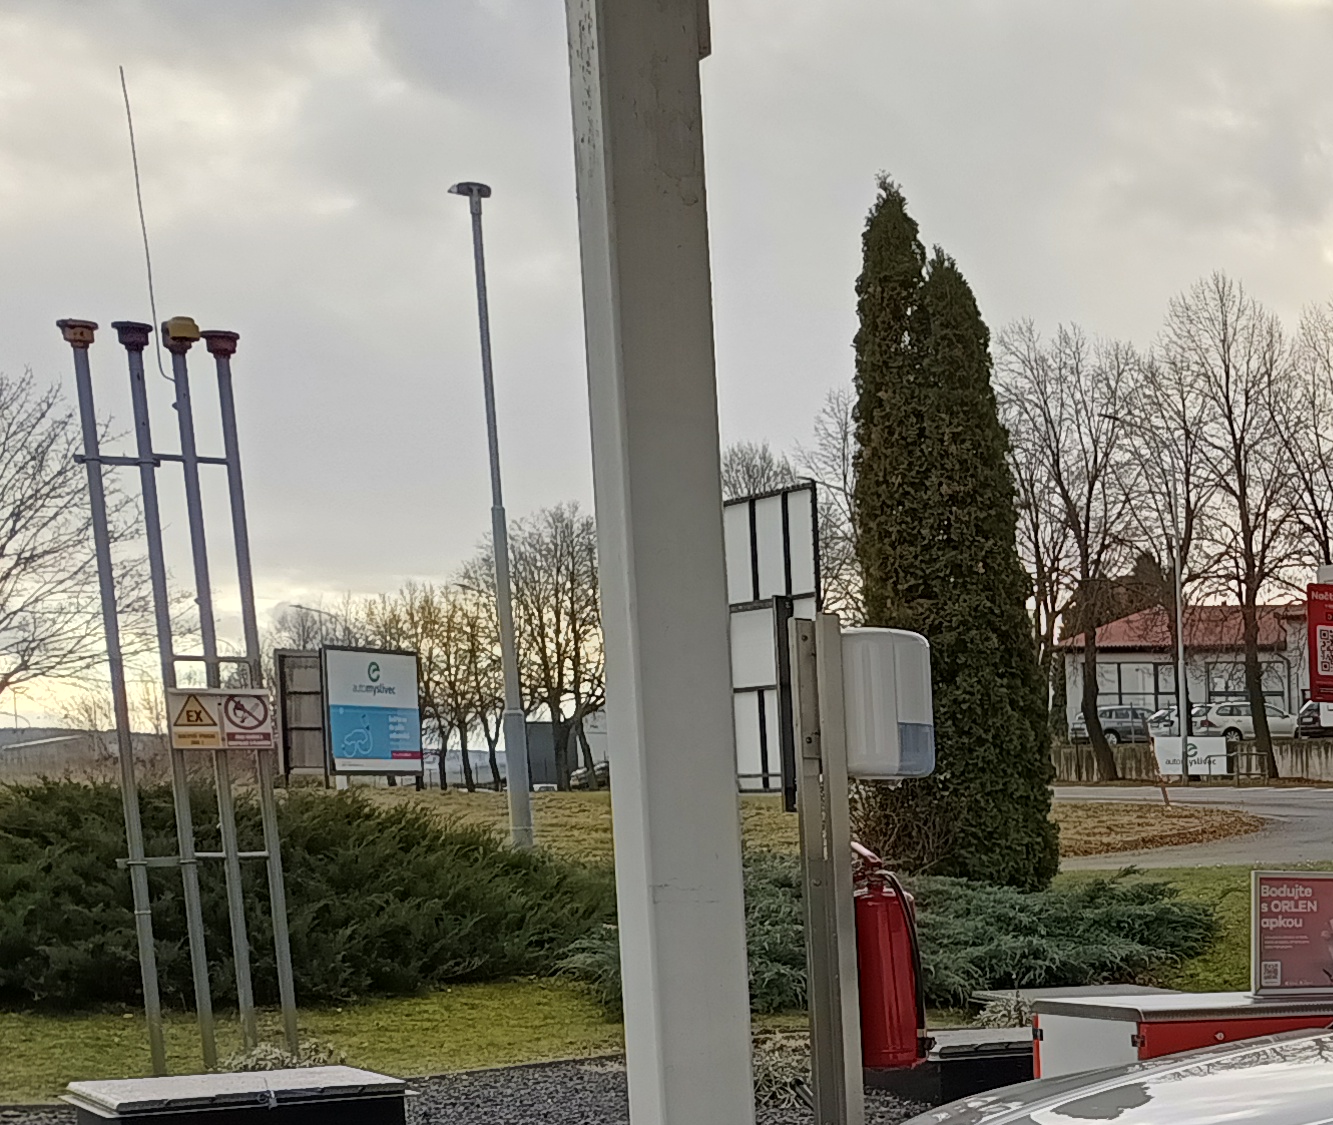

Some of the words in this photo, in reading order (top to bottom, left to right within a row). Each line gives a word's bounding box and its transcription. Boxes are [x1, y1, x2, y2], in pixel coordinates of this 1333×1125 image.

[186, 710, 203, 723] EX
[1165, 756, 1217, 767] autoyslivc
[1261, 884, 1313, 901] Bodujte
[1261, 903, 1268, 912] s
[1270, 901, 1318, 912] ORLEN
[1261, 915, 1303, 930] apkou
